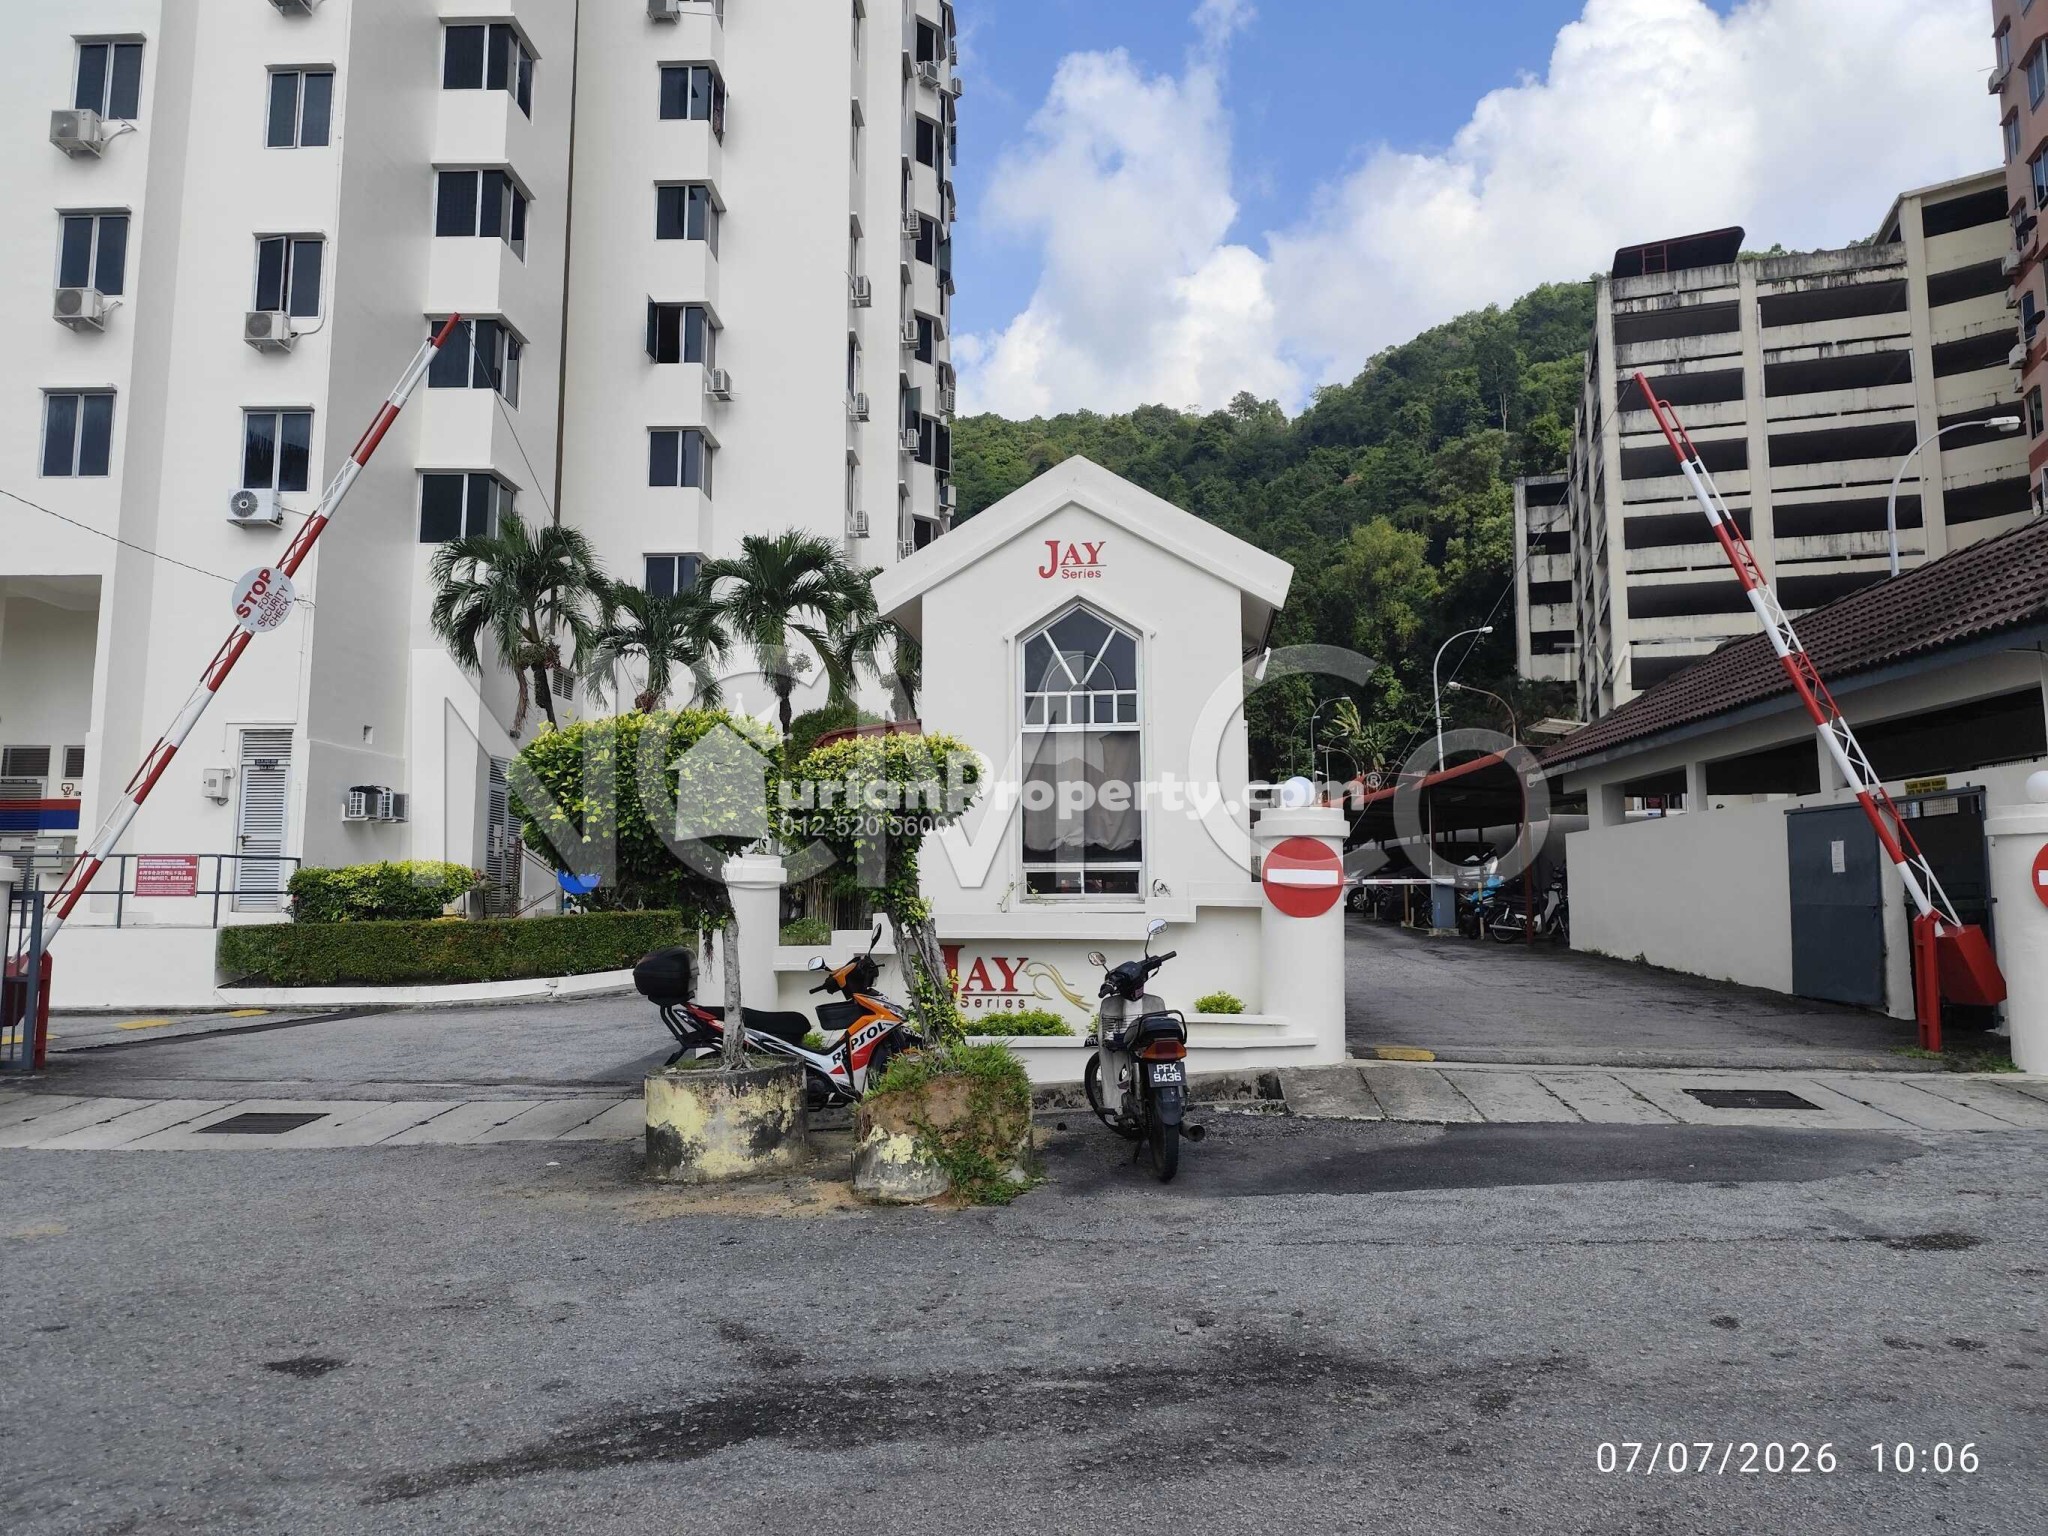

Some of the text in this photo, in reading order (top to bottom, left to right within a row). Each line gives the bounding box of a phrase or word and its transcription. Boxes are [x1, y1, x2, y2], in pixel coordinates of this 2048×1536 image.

[1039, 541, 1106, 578] JAY
[1061, 569, 1102, 579] Series
[236, 568, 271, 618] STOP
[257, 591, 274, 610] FOR
[257, 584, 288, 627] SECURITY
[268, 597, 292, 627] CHECK
[960, 996, 1026, 1009] Series
[1153, 1072, 1182, 1083] 9436
[1156, 1063, 1178, 1073] PFK
